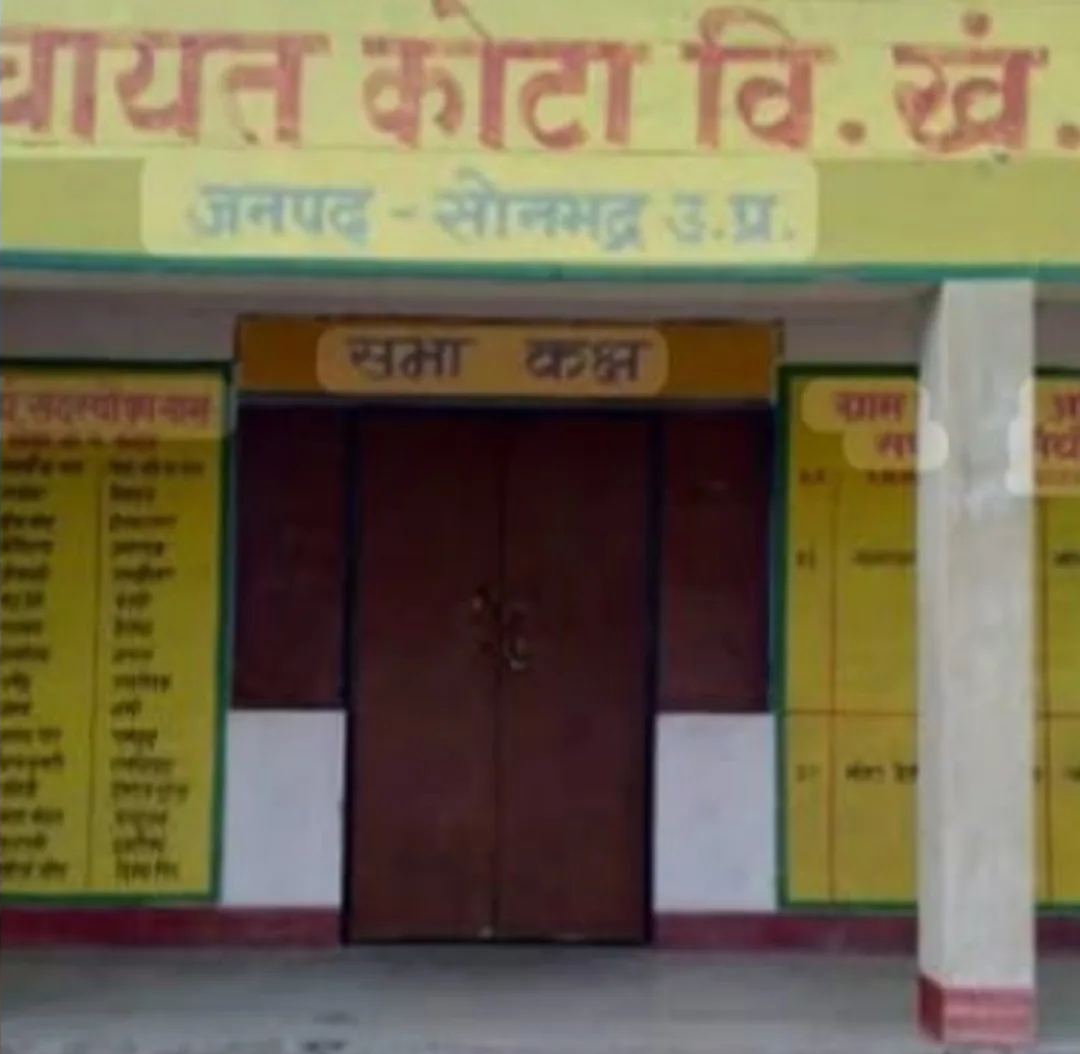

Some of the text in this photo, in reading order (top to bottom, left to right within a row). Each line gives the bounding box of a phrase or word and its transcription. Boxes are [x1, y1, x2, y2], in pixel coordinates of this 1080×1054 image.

[361, 0, 652, 150] कोटा
[184, 184, 376, 245] जनपद
[432, 166, 652, 252] सोनभद्र
[523, 339, 655, 384] कक्ष
